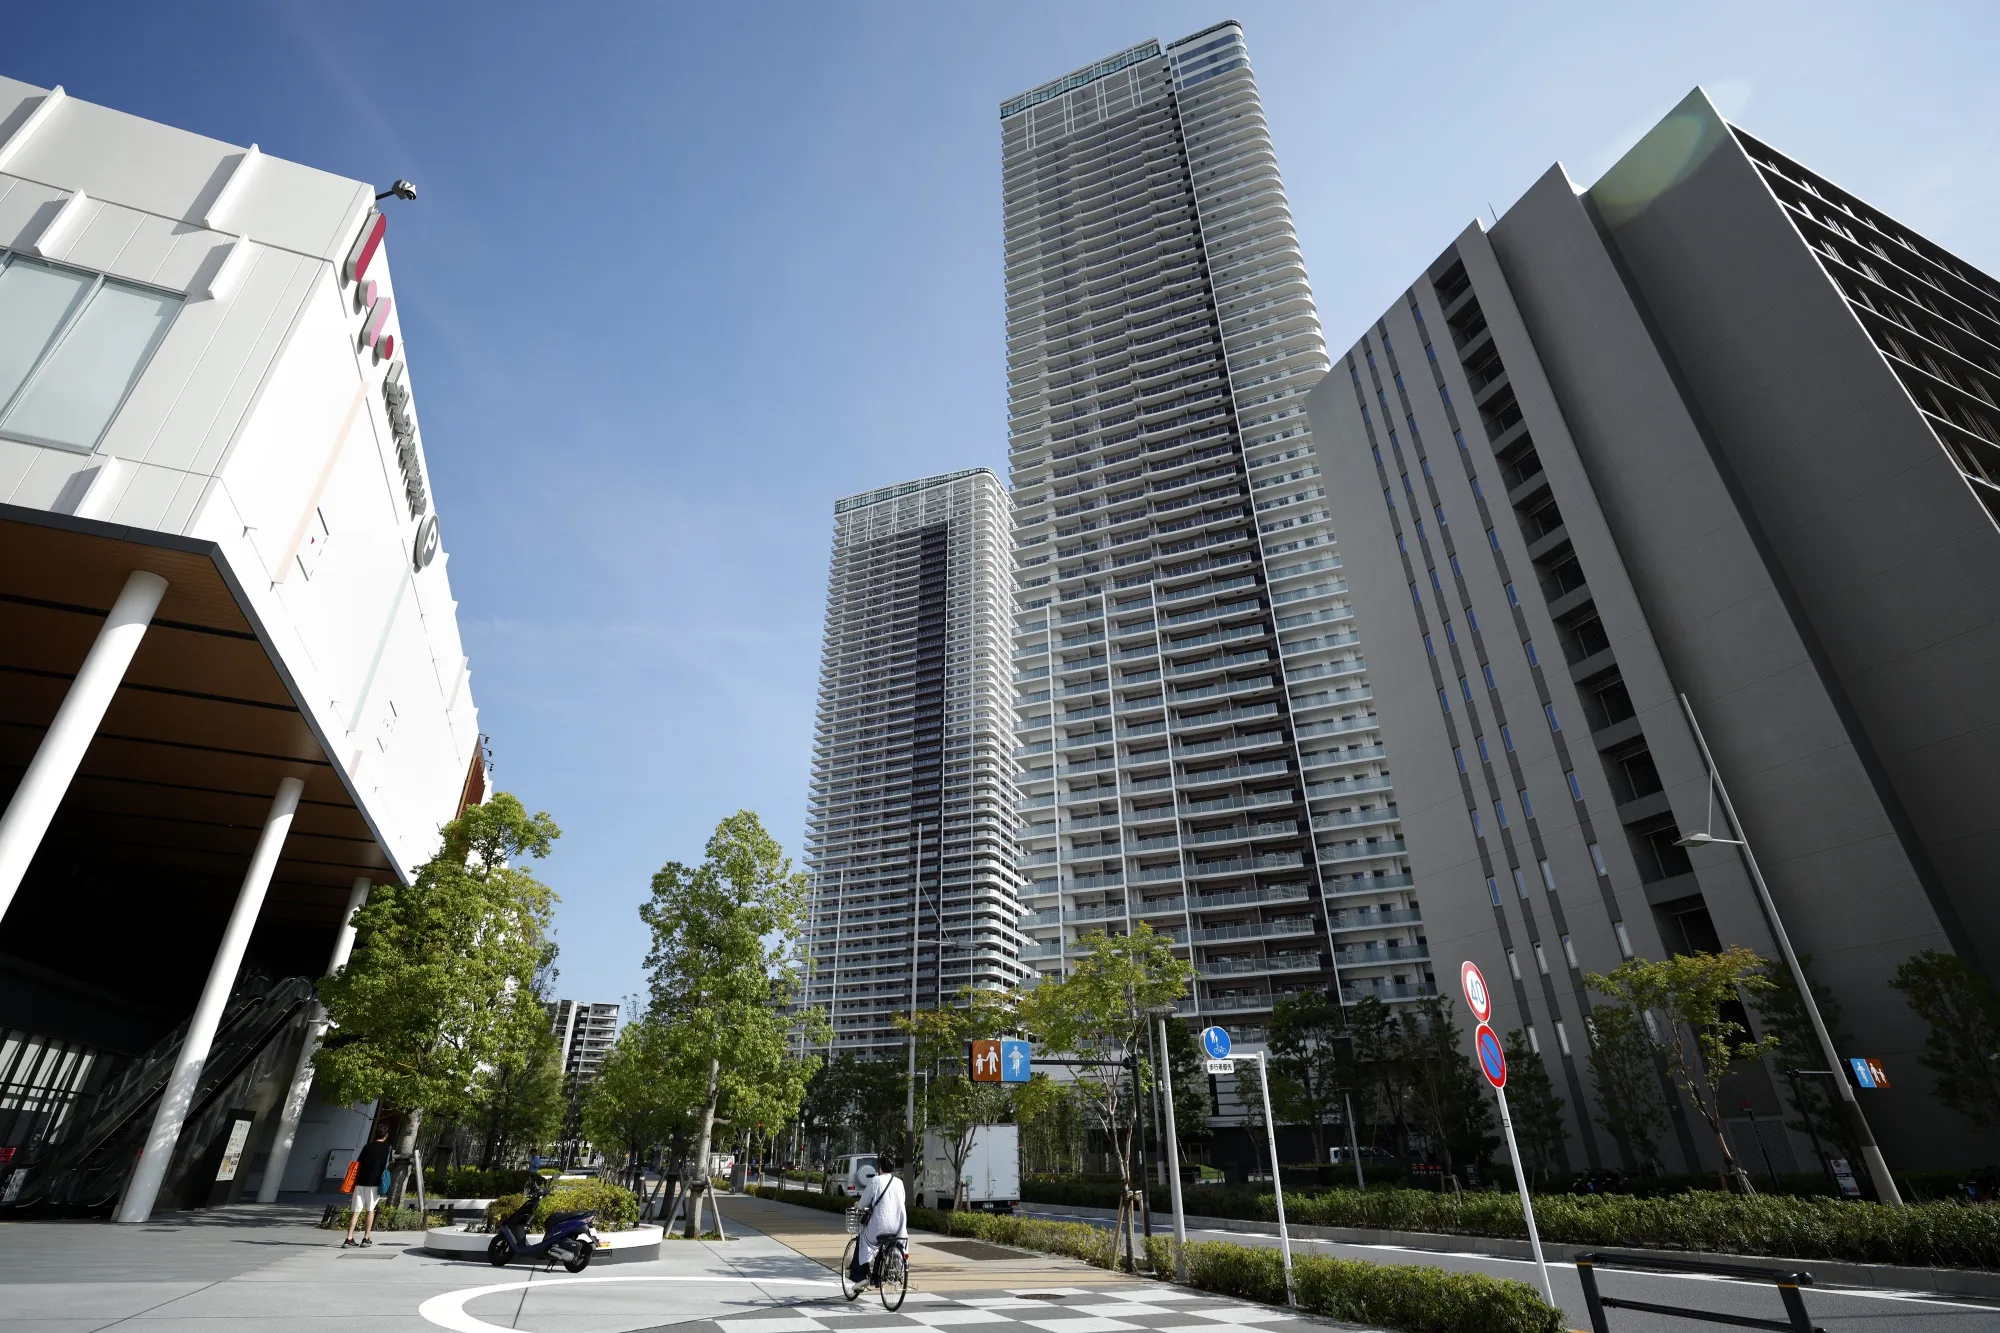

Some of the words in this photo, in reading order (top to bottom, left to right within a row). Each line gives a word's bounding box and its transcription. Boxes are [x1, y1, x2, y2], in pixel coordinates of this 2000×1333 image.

[1470, 979, 1485, 1005] 40
[1209, 1063, 1233, 1071] 歩行者優先
